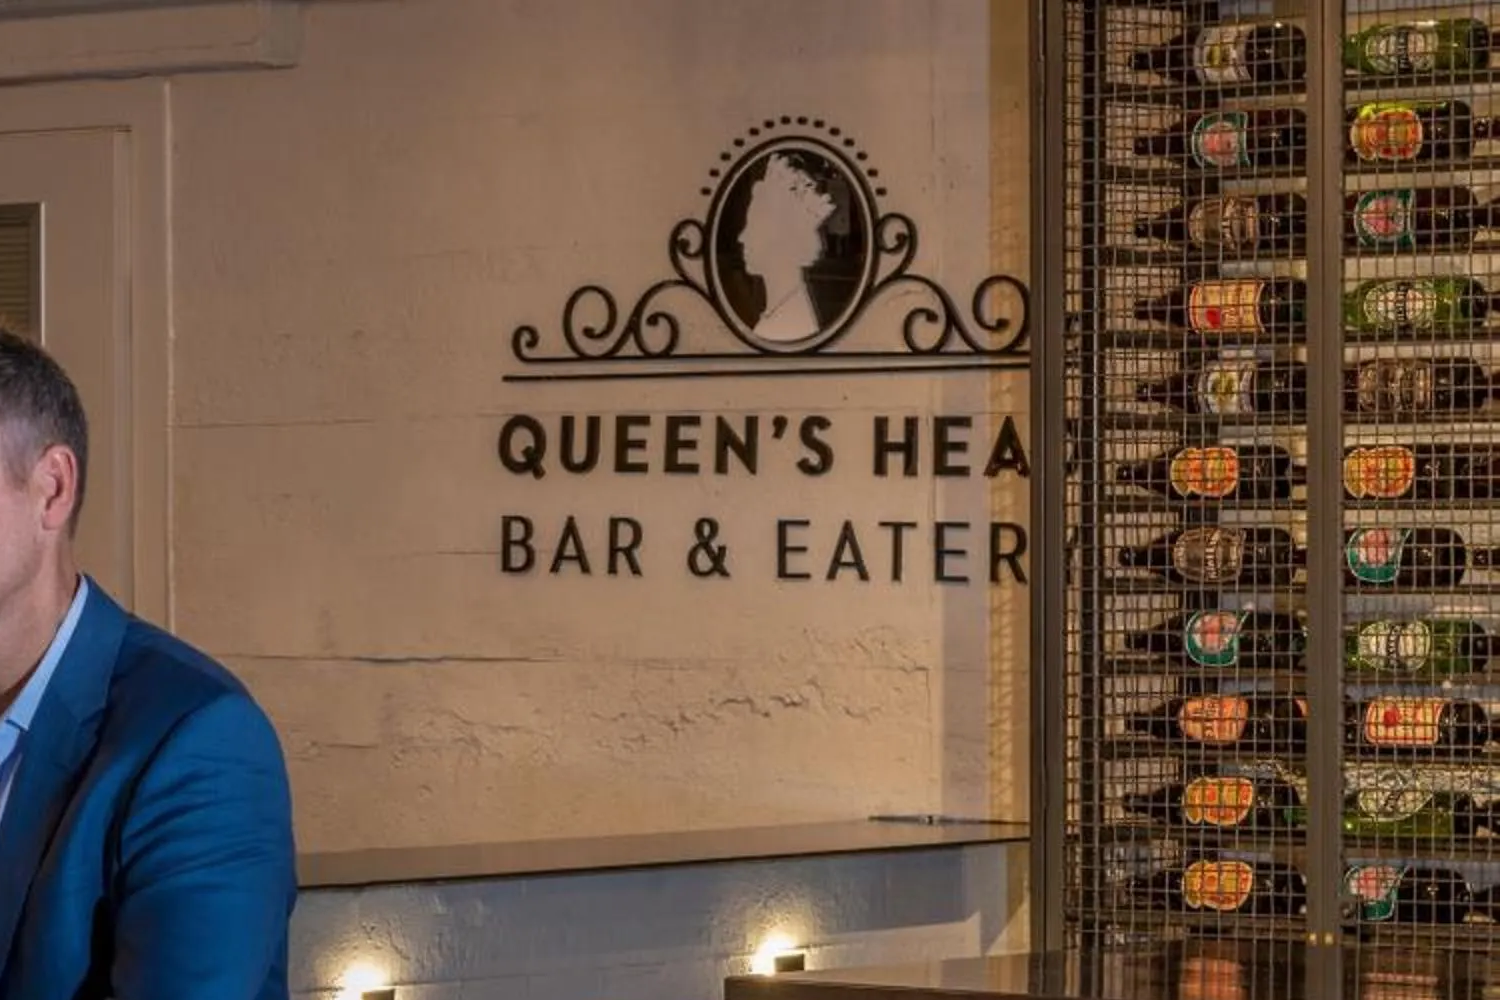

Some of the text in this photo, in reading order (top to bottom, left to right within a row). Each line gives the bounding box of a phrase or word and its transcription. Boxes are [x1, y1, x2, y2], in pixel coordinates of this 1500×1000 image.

[498, 414, 1031, 480] QUEEN'S HEA
[501, 514, 1029, 585] BAR & EATER
